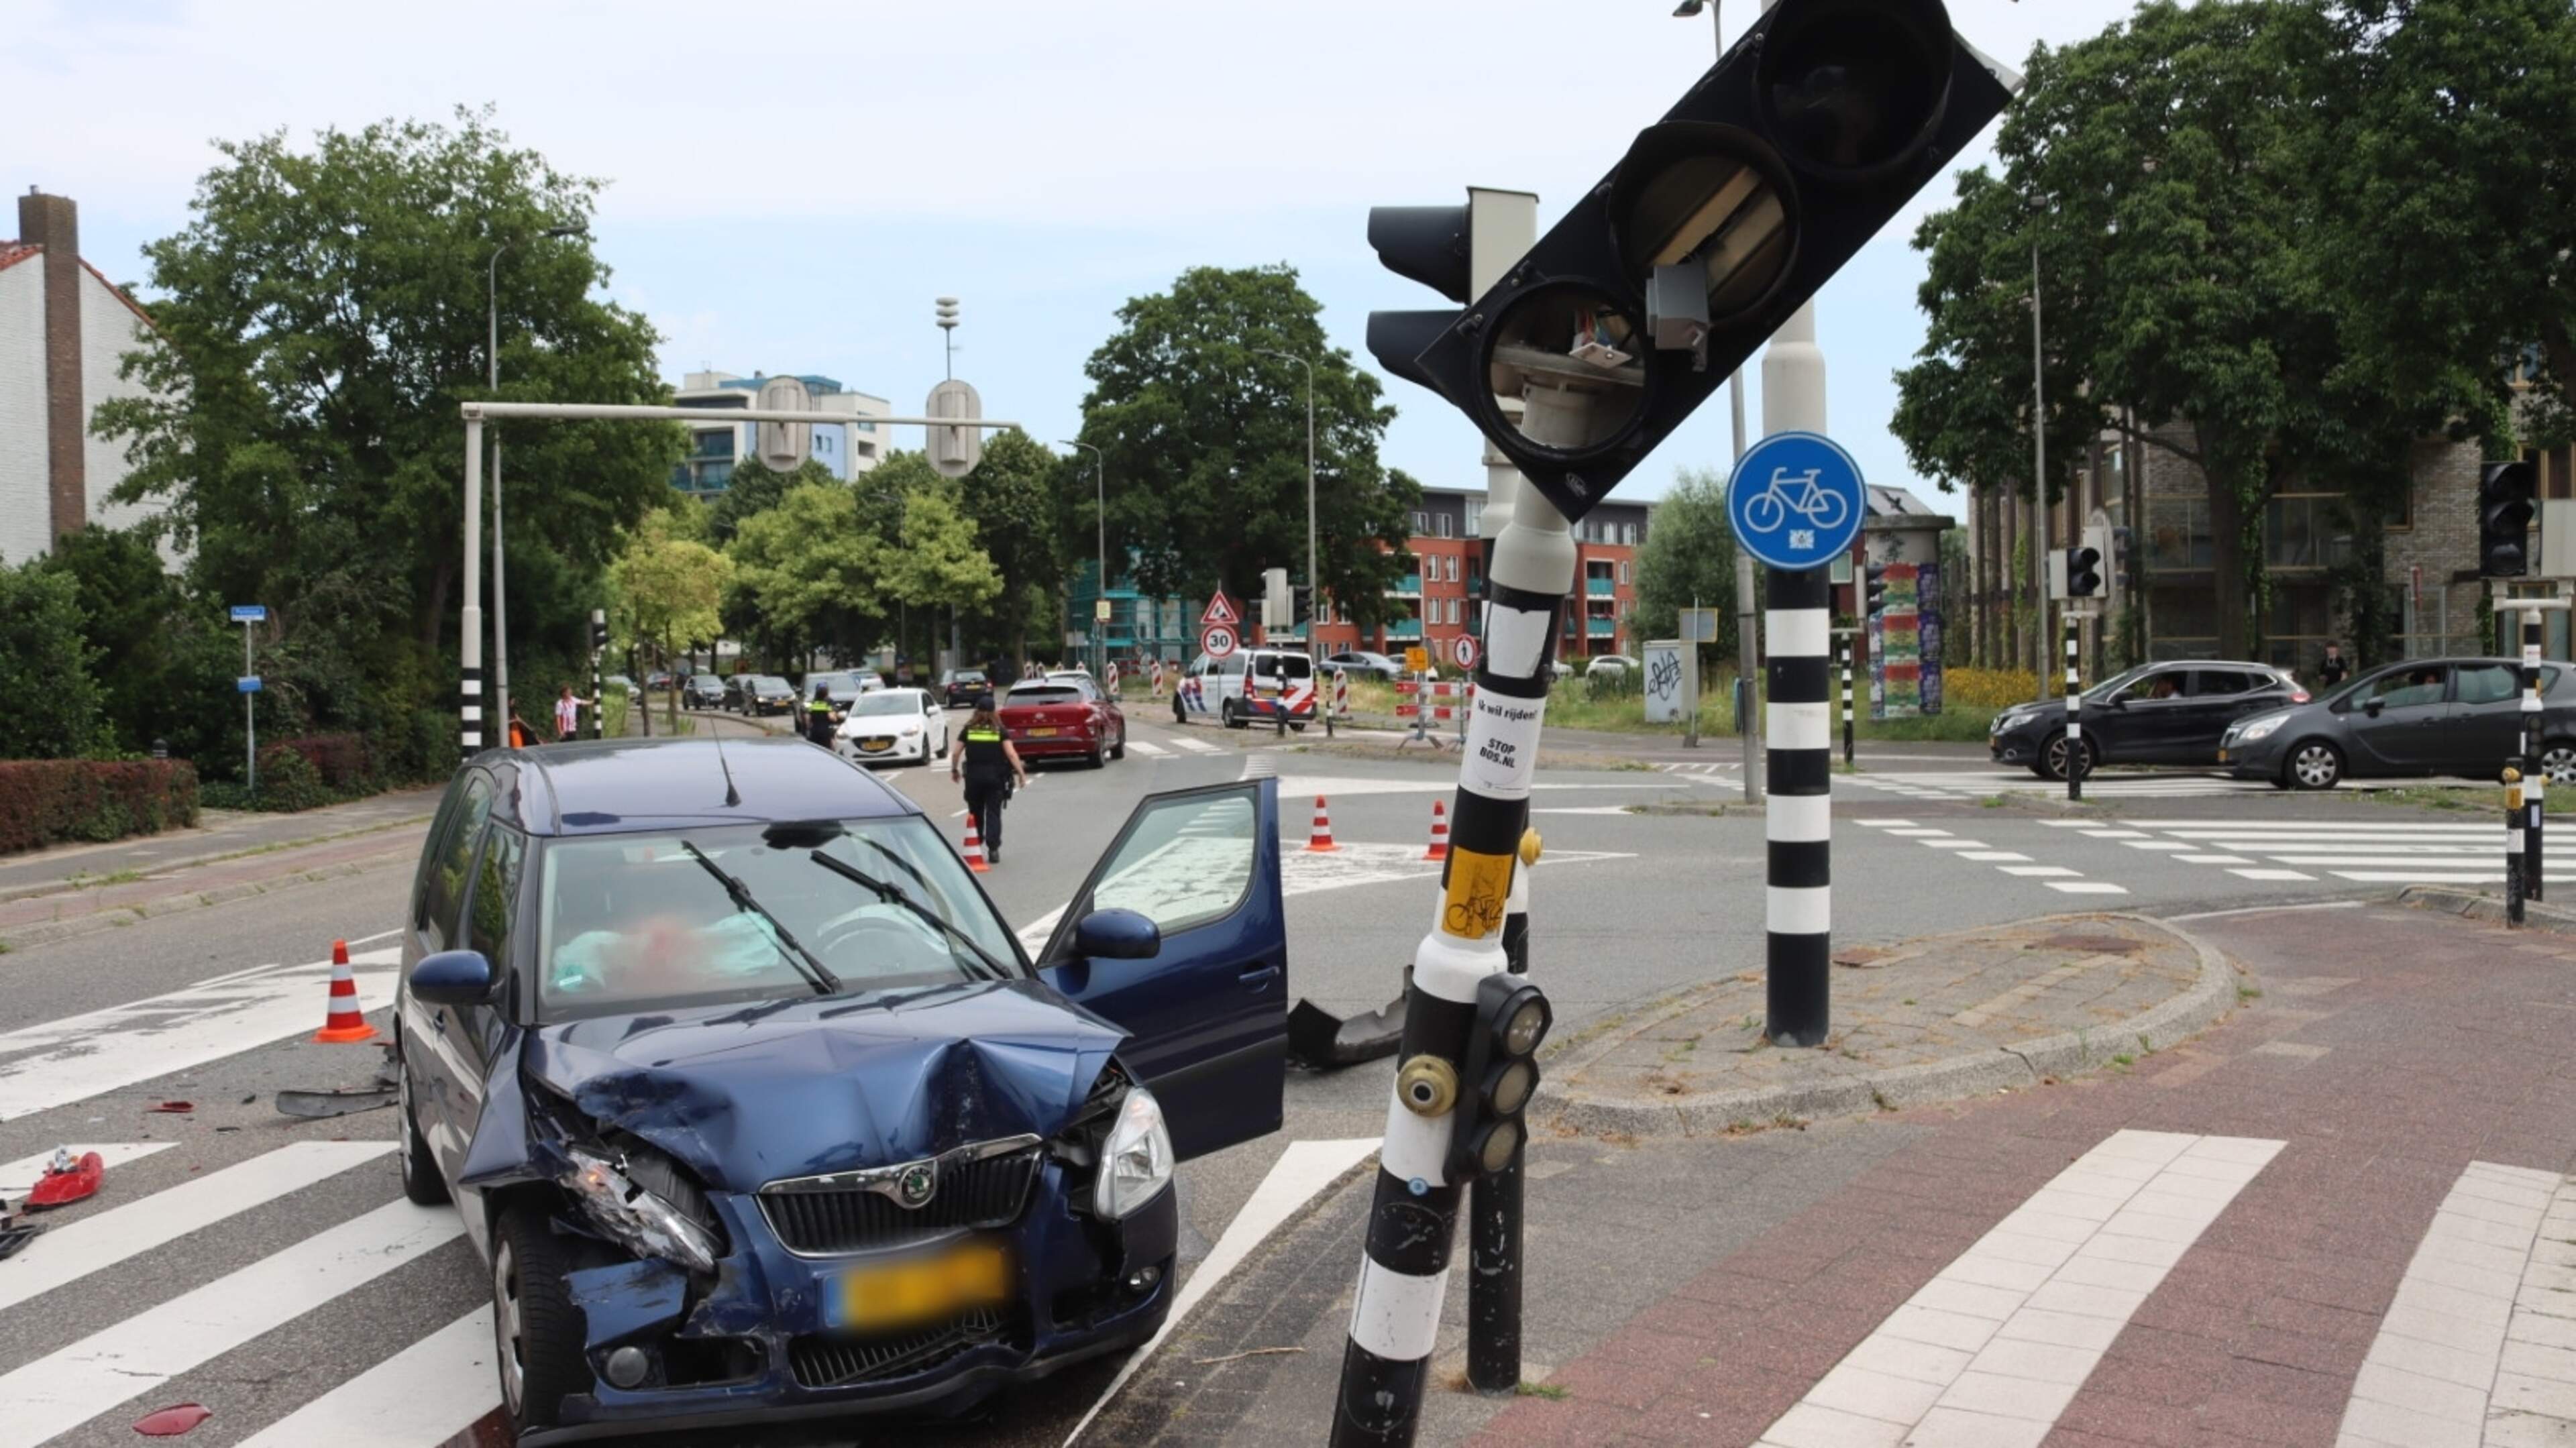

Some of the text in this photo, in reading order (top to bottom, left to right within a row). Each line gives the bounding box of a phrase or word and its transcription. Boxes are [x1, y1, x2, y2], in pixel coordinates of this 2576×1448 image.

[1210, 634, 1228, 647] 30
[1487, 706, 1503, 716] wil
[1504, 709, 1538, 722] rijden!
[1488, 738, 1515, 755] STOP
[1480, 746, 1514, 768] BOS.NL
